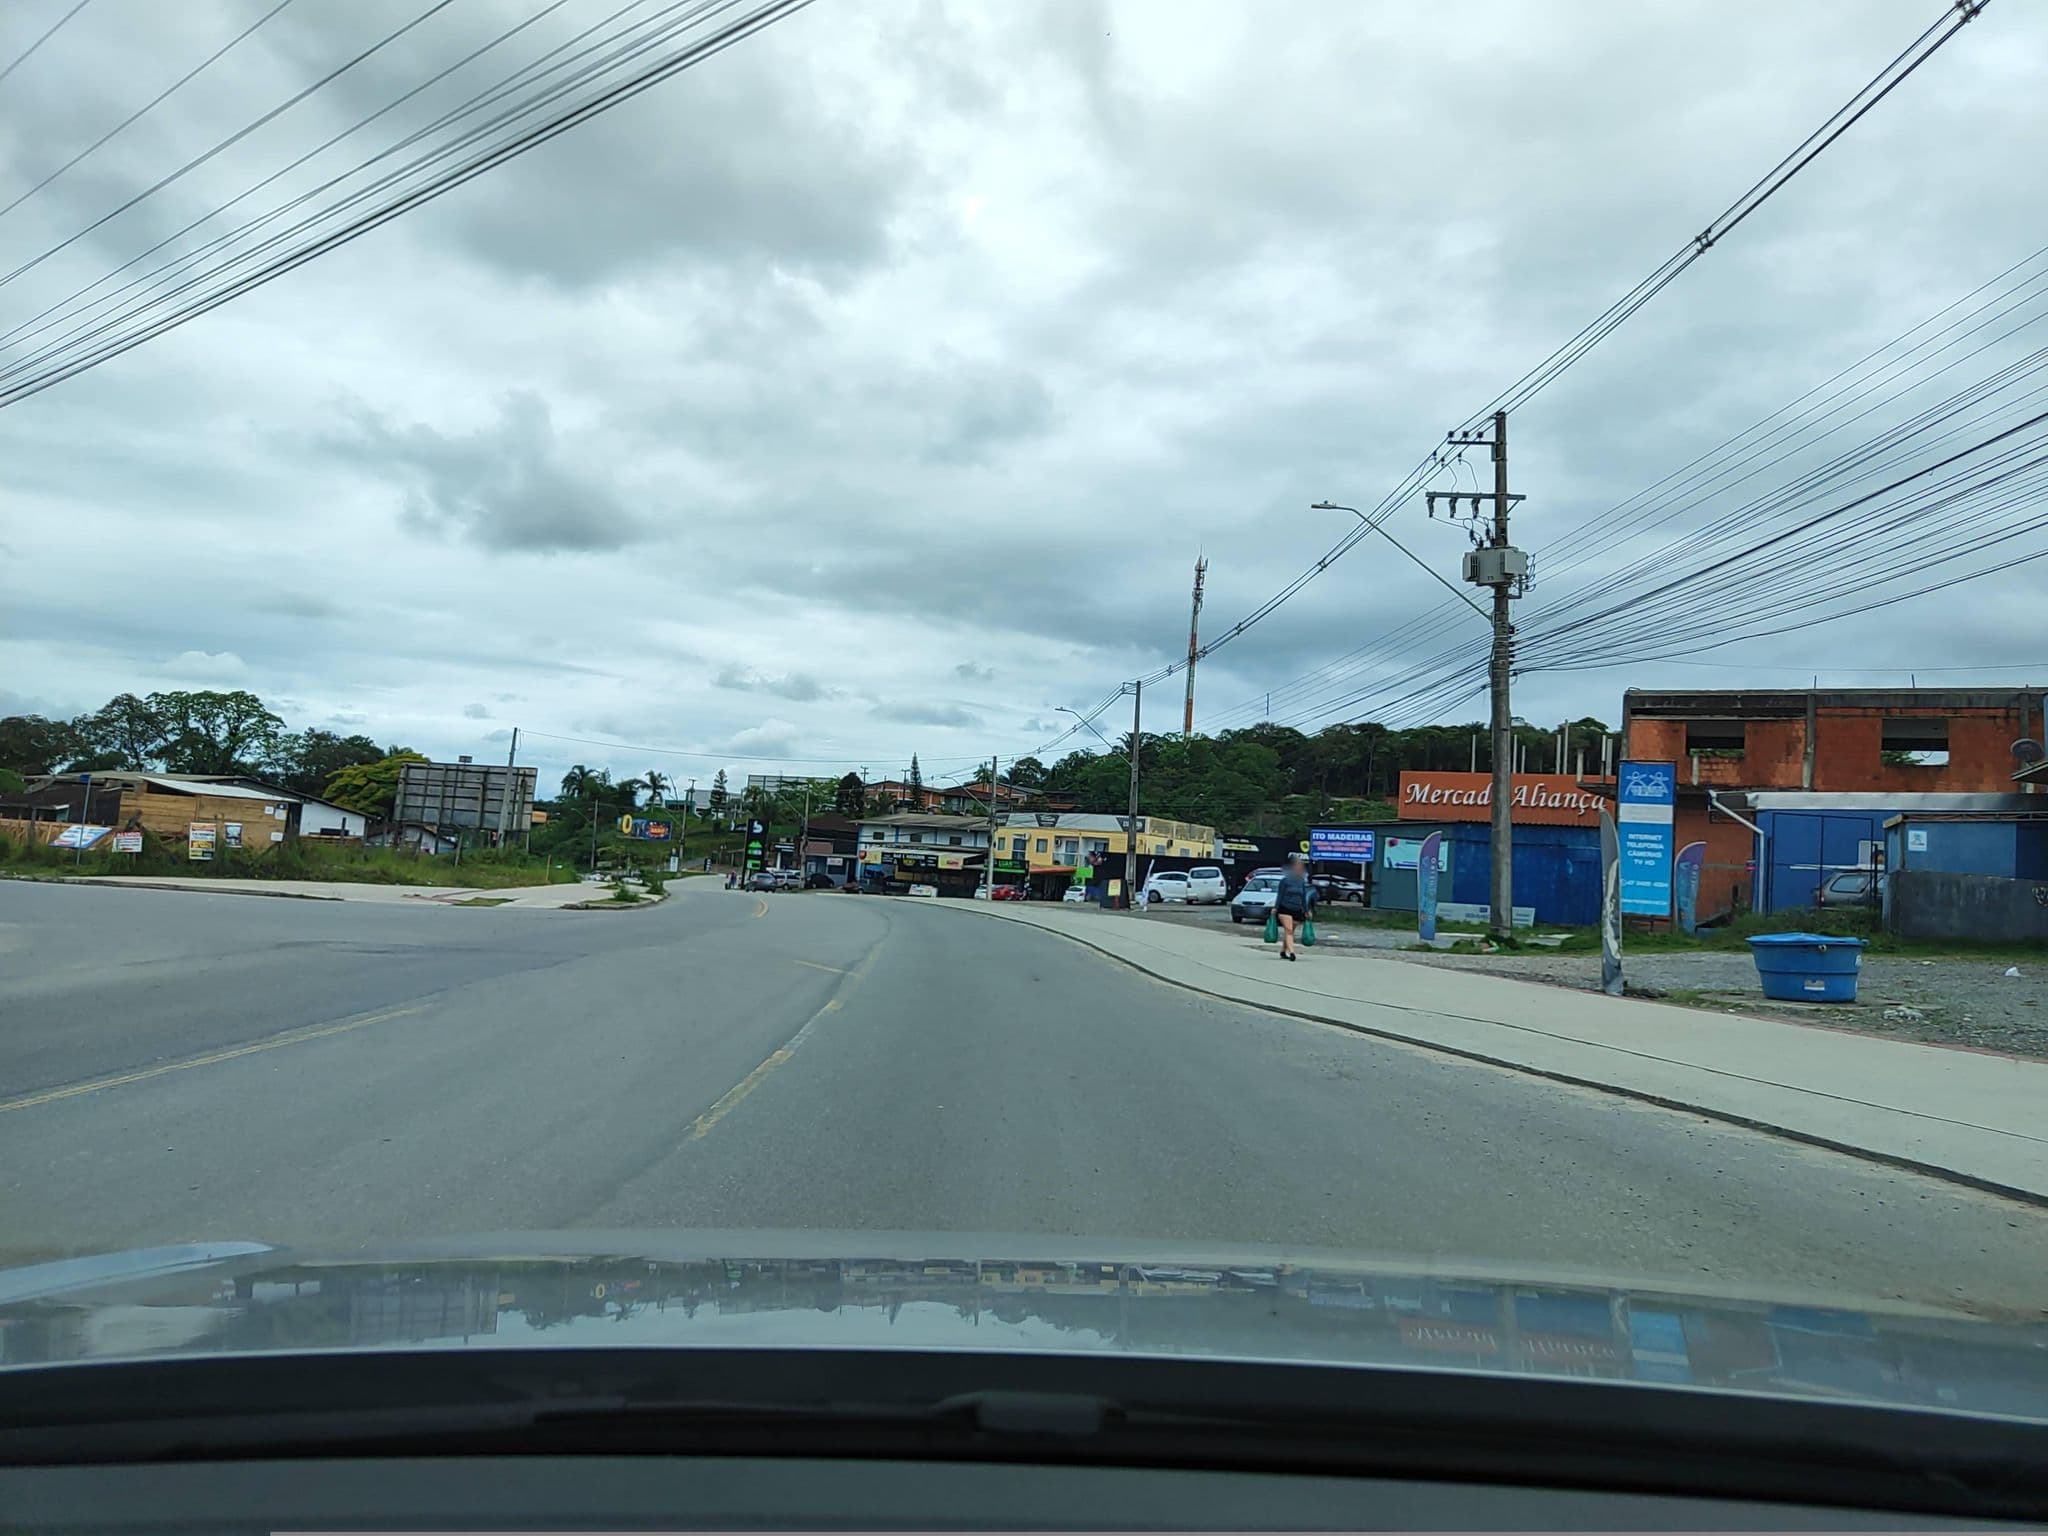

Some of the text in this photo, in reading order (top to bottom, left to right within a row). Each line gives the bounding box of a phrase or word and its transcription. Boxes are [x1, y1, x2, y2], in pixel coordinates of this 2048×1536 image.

[1404, 782, 1493, 806] Mercad
[1511, 783, 1606, 815] Aliança
[1327, 833, 1372, 841] MADEIRAS
[1628, 833, 1663, 841] INTERNET
[1626, 841, 1665, 849] TELEFONIA
